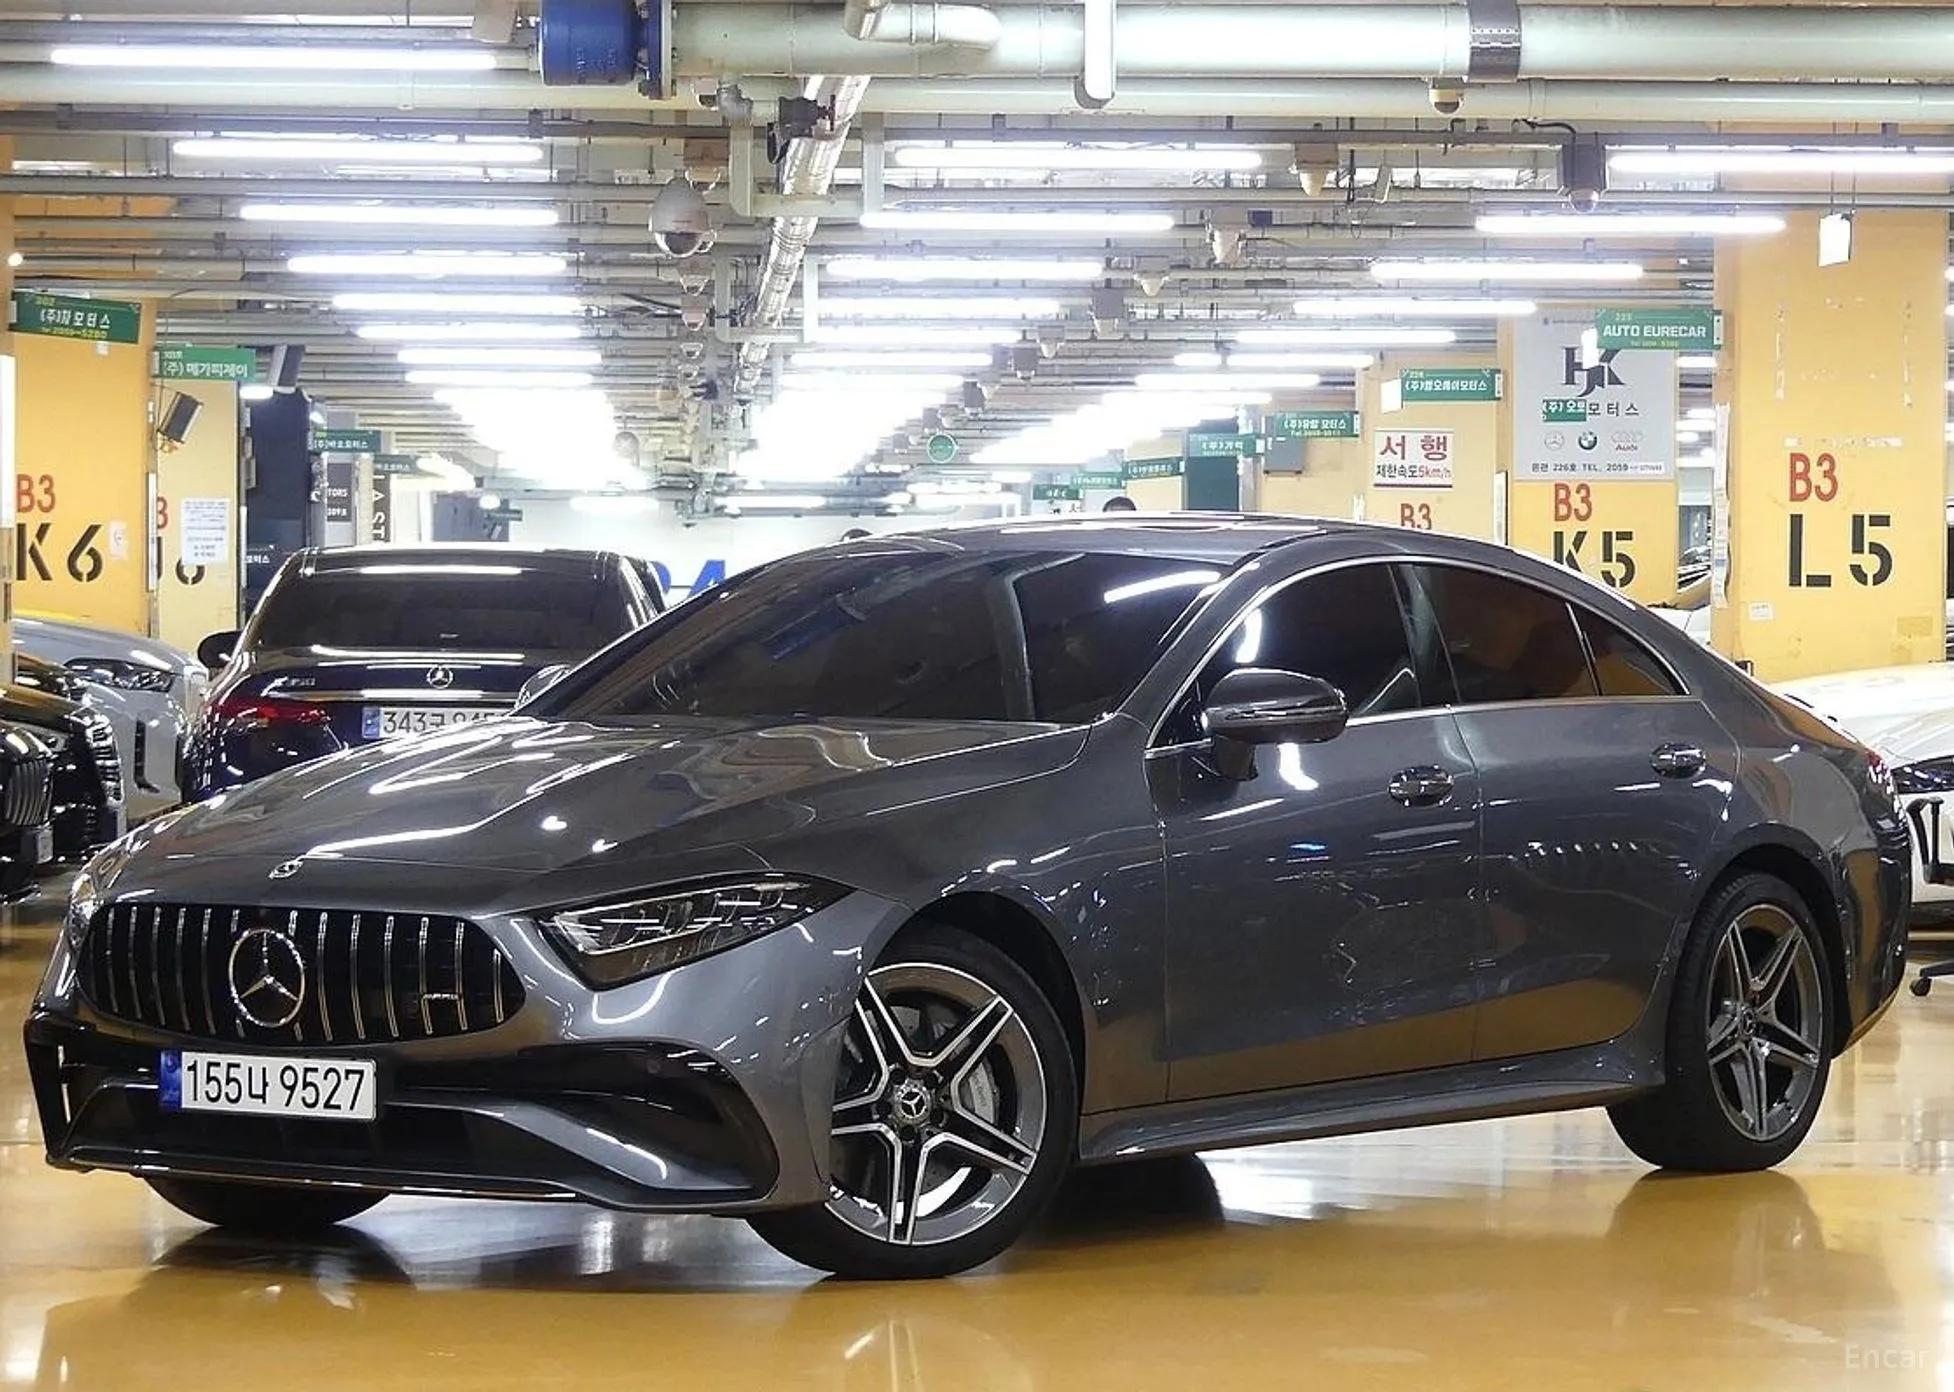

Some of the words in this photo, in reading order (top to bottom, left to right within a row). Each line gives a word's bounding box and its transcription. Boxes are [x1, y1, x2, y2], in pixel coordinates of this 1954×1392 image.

[1603, 324, 1640, 337] AUTO
[1643, 324, 1706, 337] EURECAR
[16, 473, 56, 514] B3
[1790, 452, 1838, 502] B3
[1554, 483, 1592, 522] B3
[279, 1064, 365, 1111] 9527
